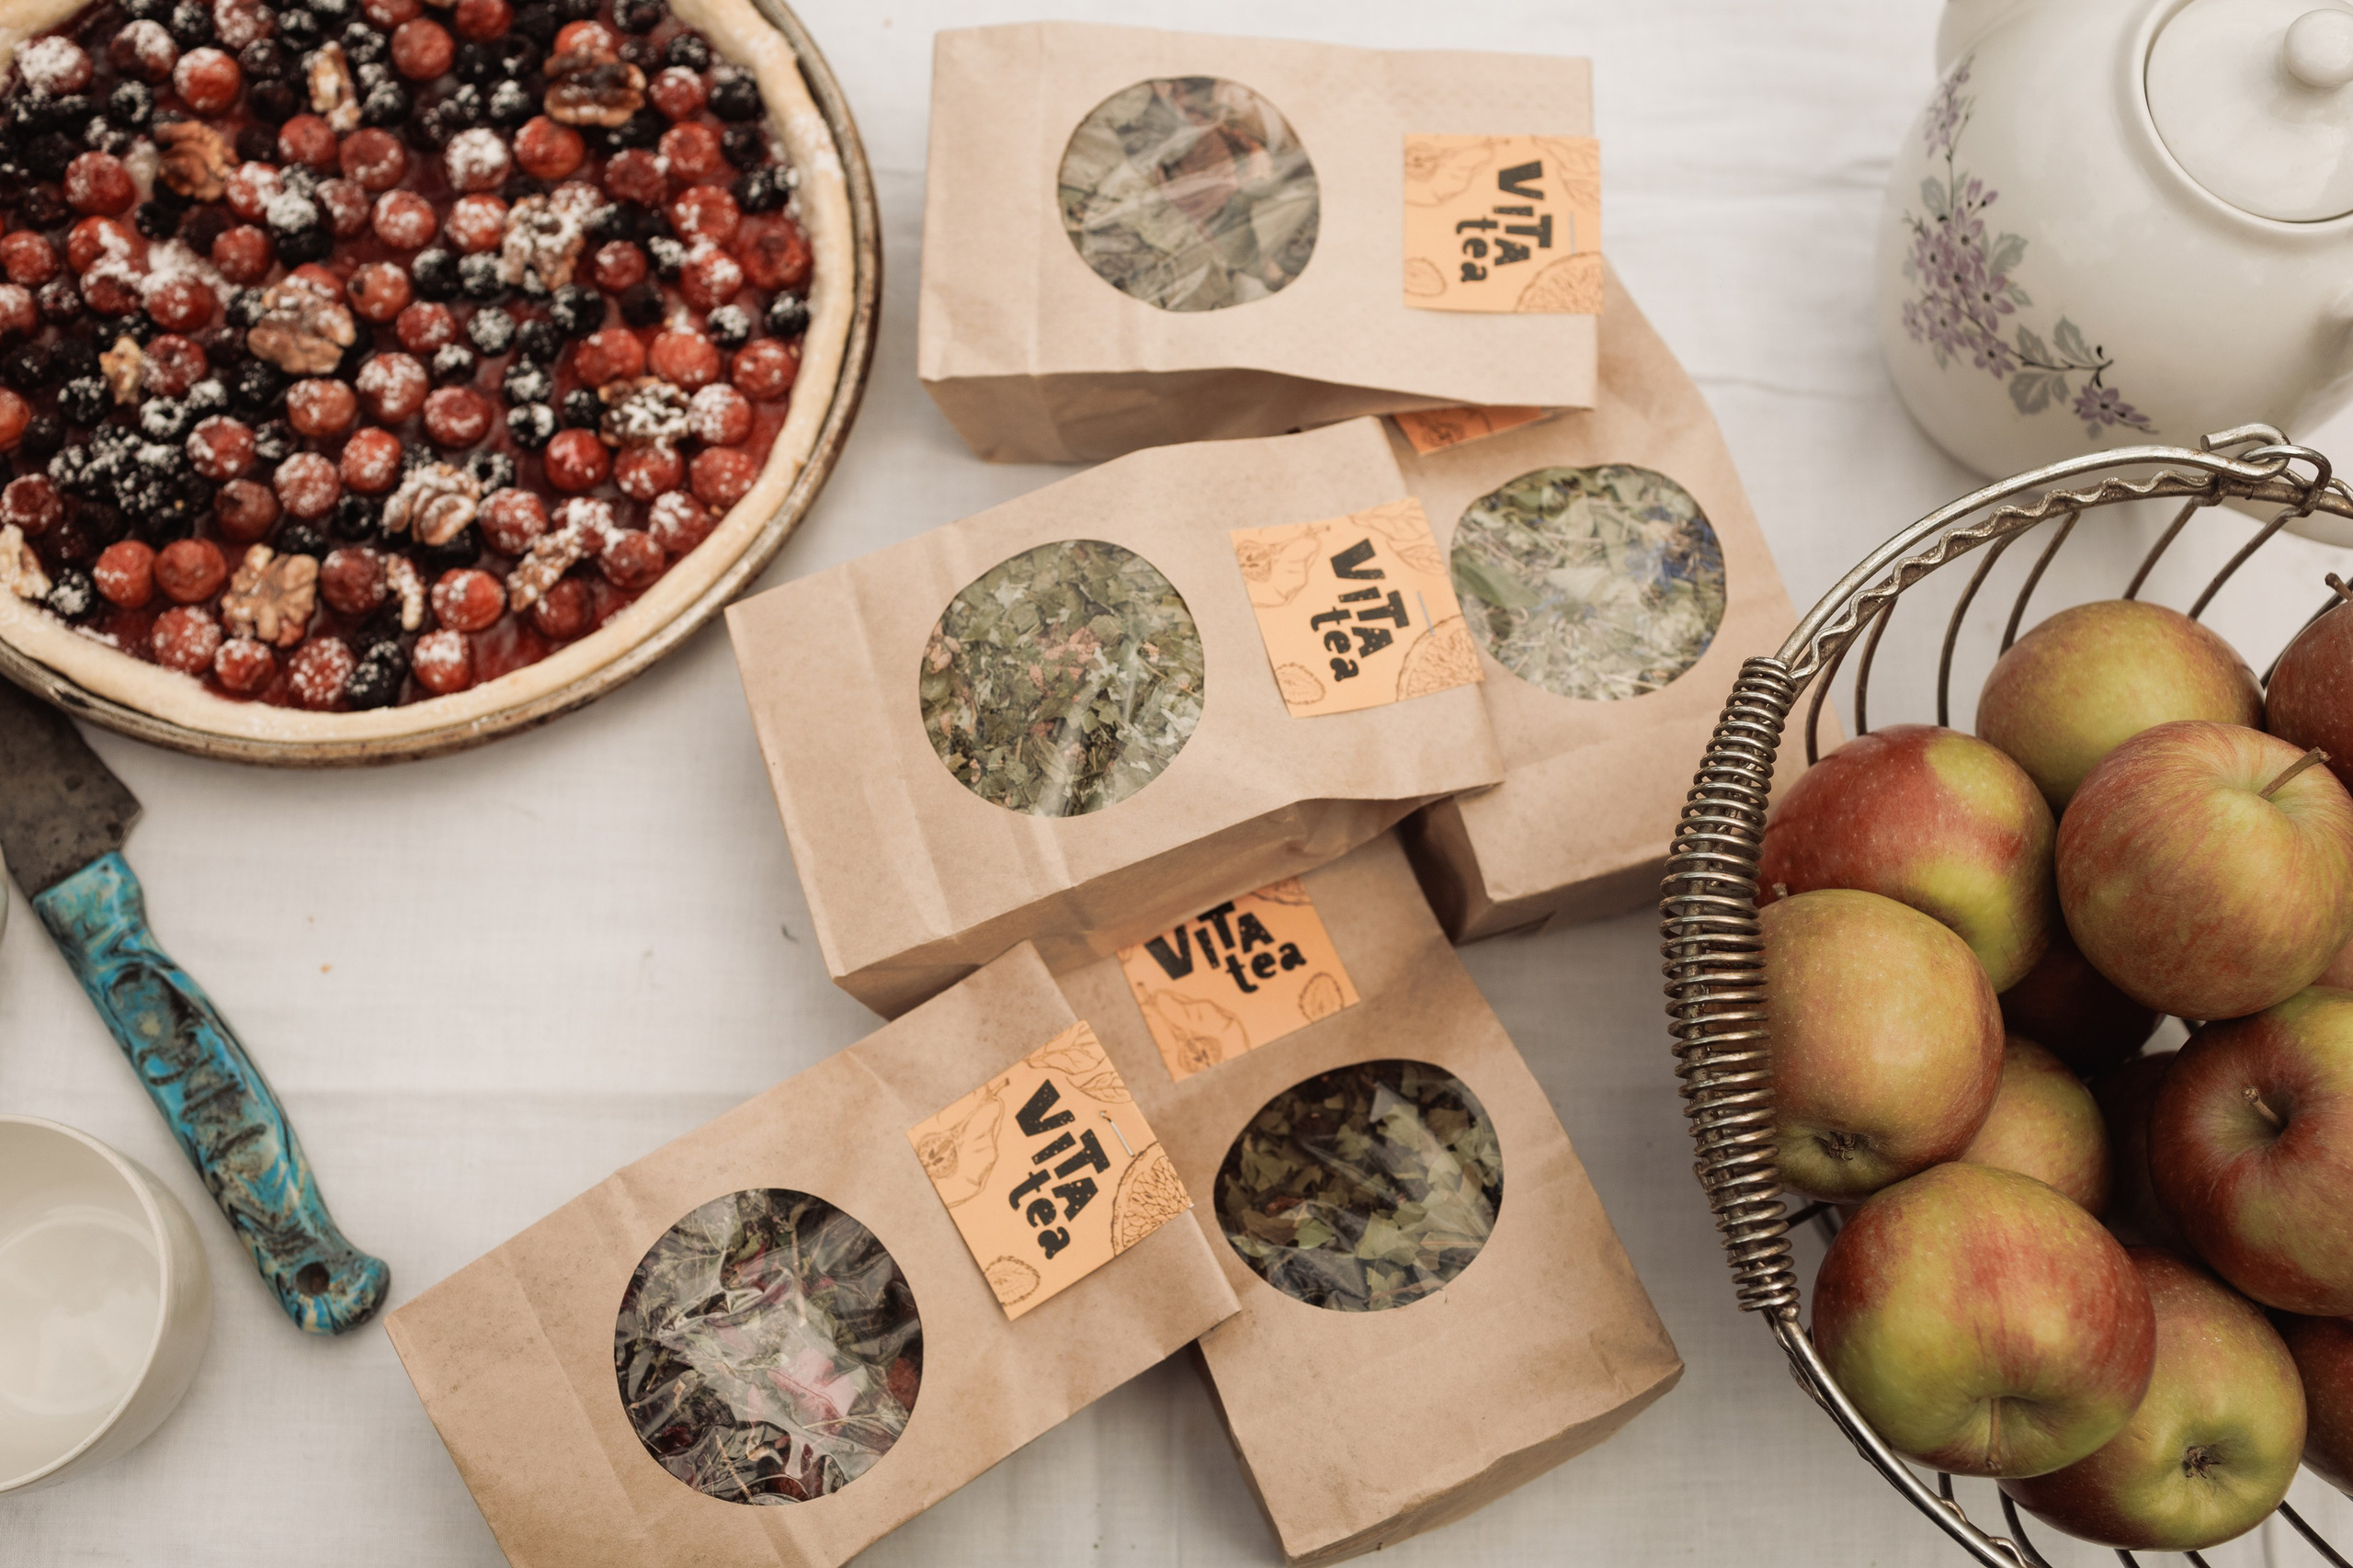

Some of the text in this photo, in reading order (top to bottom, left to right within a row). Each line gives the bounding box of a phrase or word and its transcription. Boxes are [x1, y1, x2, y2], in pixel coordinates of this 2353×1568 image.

[1455, 215, 1498, 283] tea
[1493, 160, 1552, 267] VITA
[1330, 538, 1410, 658] VITA
[1310, 606, 1359, 682] tea
[1143, 900, 1276, 981] VITA
[1224, 941, 1307, 994] tea
[1015, 1078, 1110, 1222] VITA
[1008, 1168, 1071, 1260] tea
